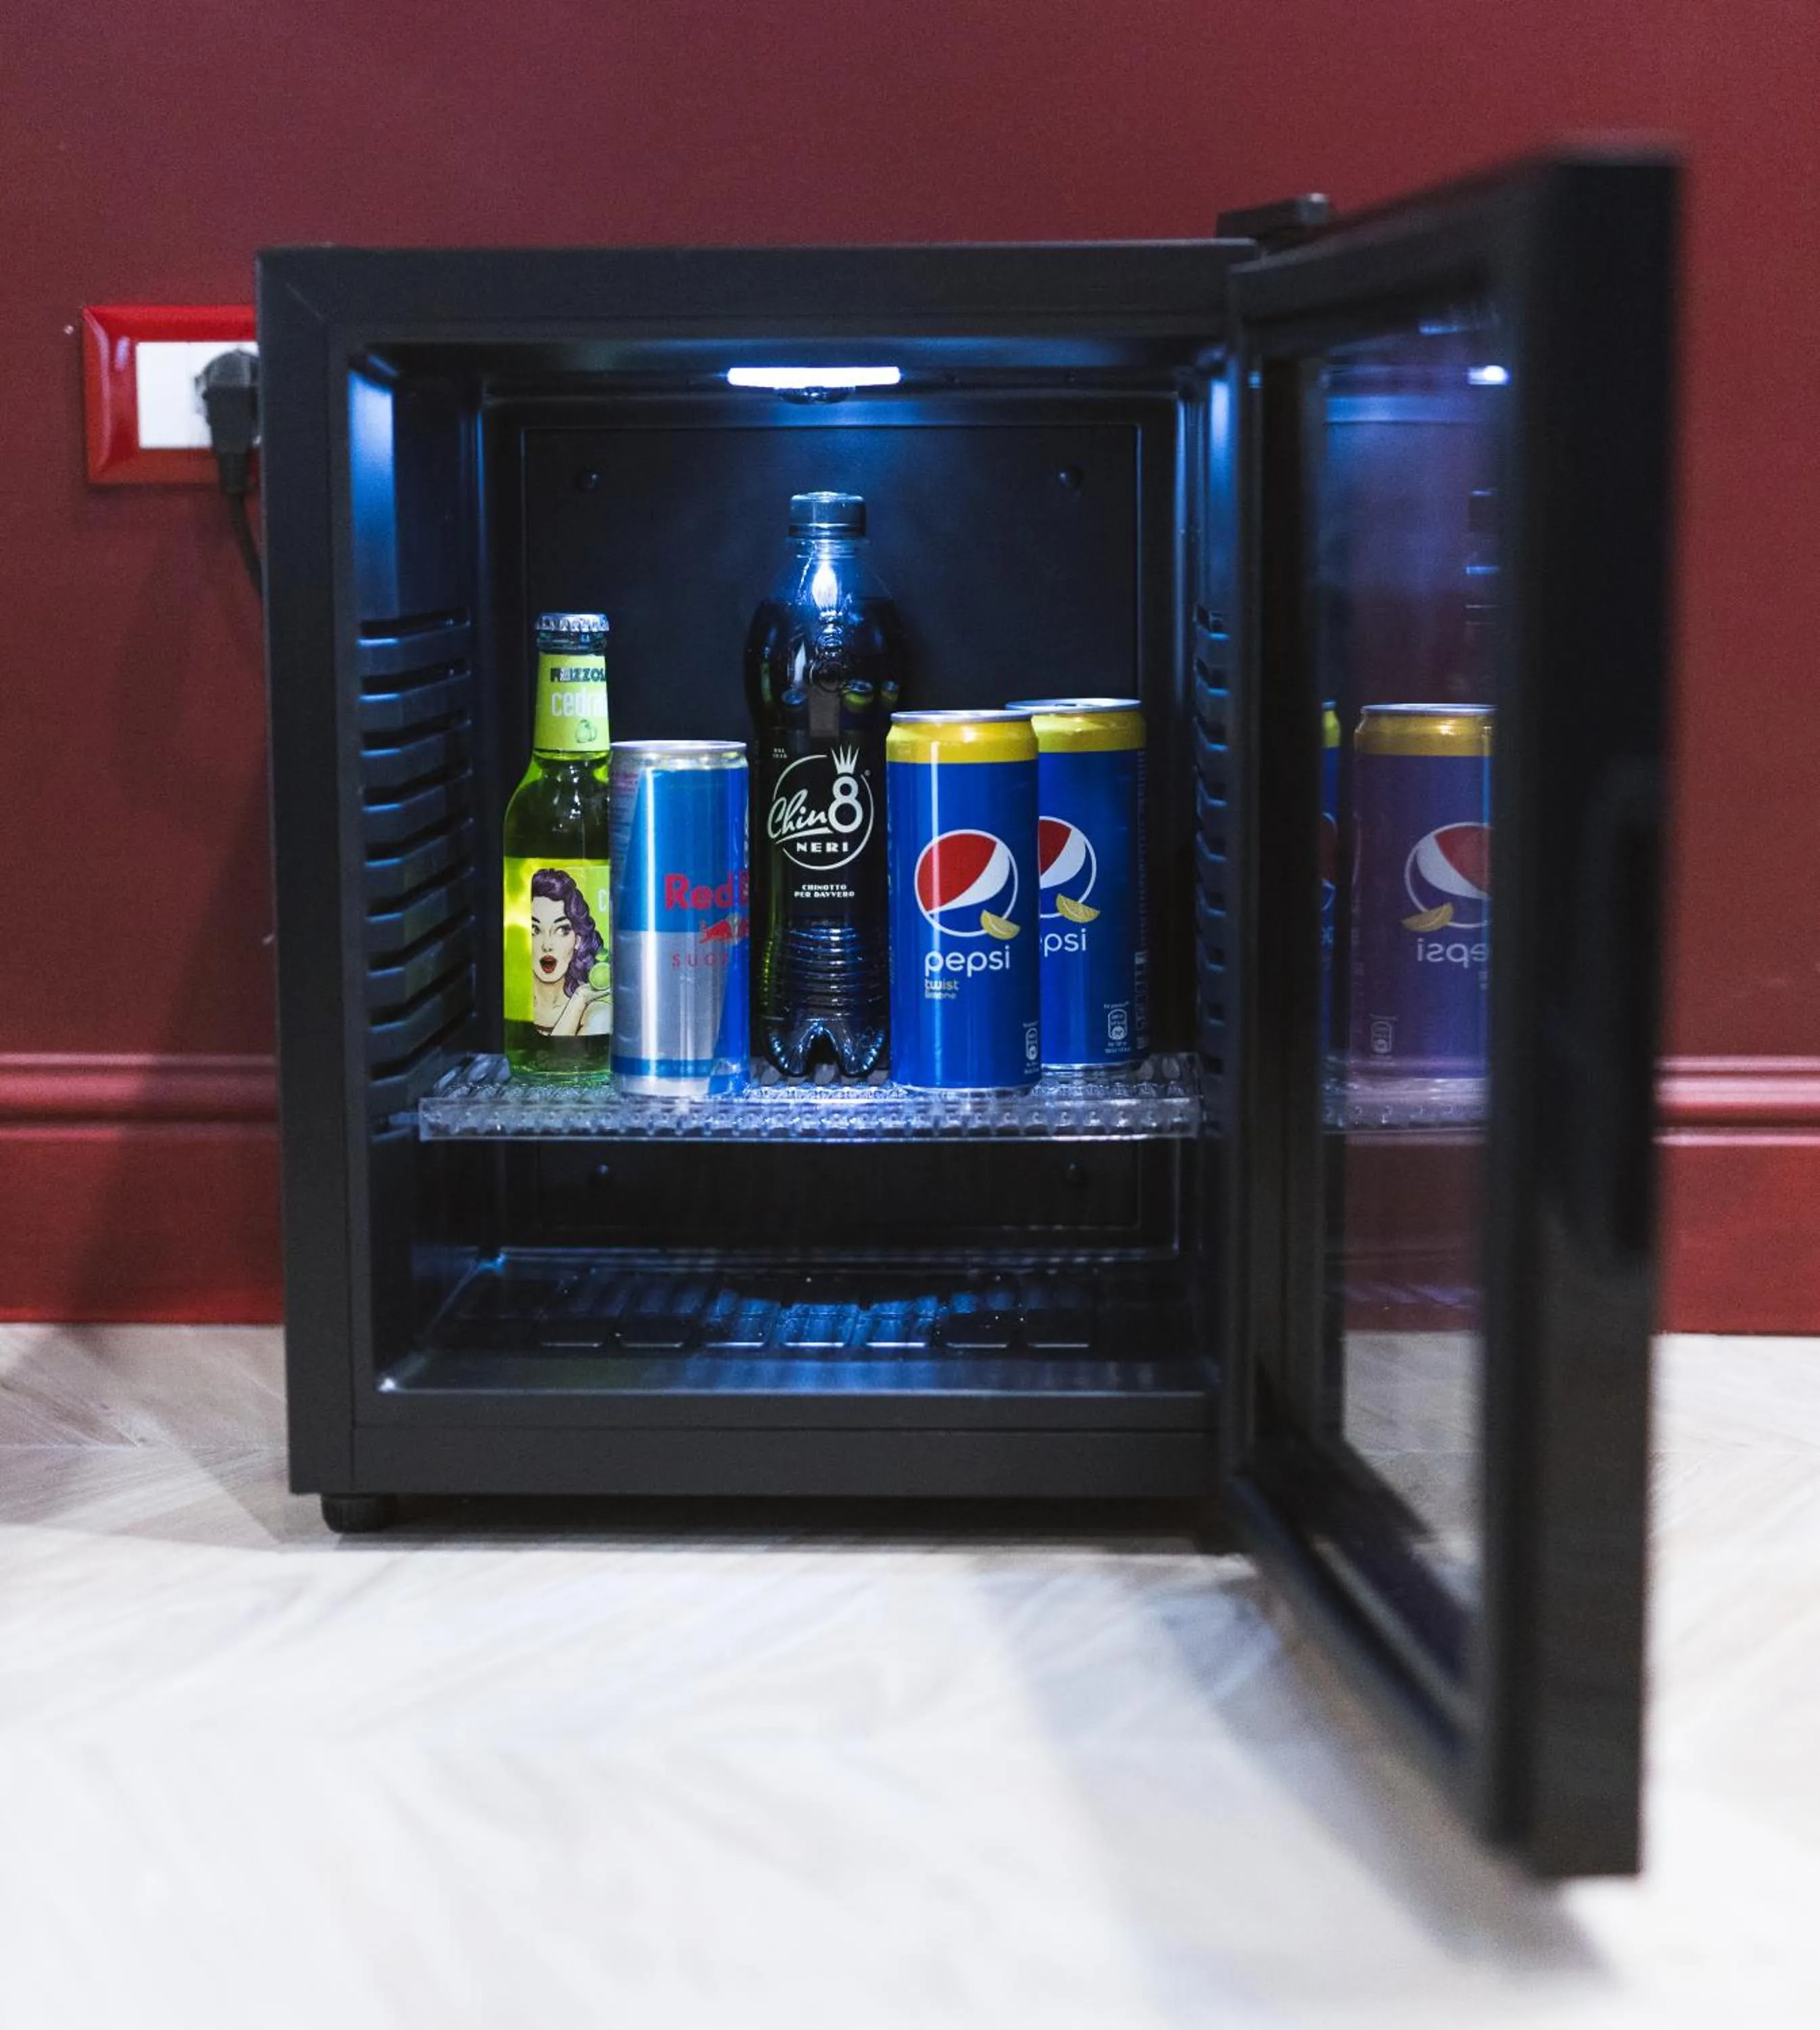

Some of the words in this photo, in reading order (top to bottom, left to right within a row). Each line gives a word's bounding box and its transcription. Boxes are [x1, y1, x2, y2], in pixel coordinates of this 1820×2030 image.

[796, 842, 848, 853] NERI
[665, 871, 734, 910] Red
[1040, 928, 1087, 958] psi
[925, 945, 1010, 978] pepsi
[925, 978, 959, 990] twist
